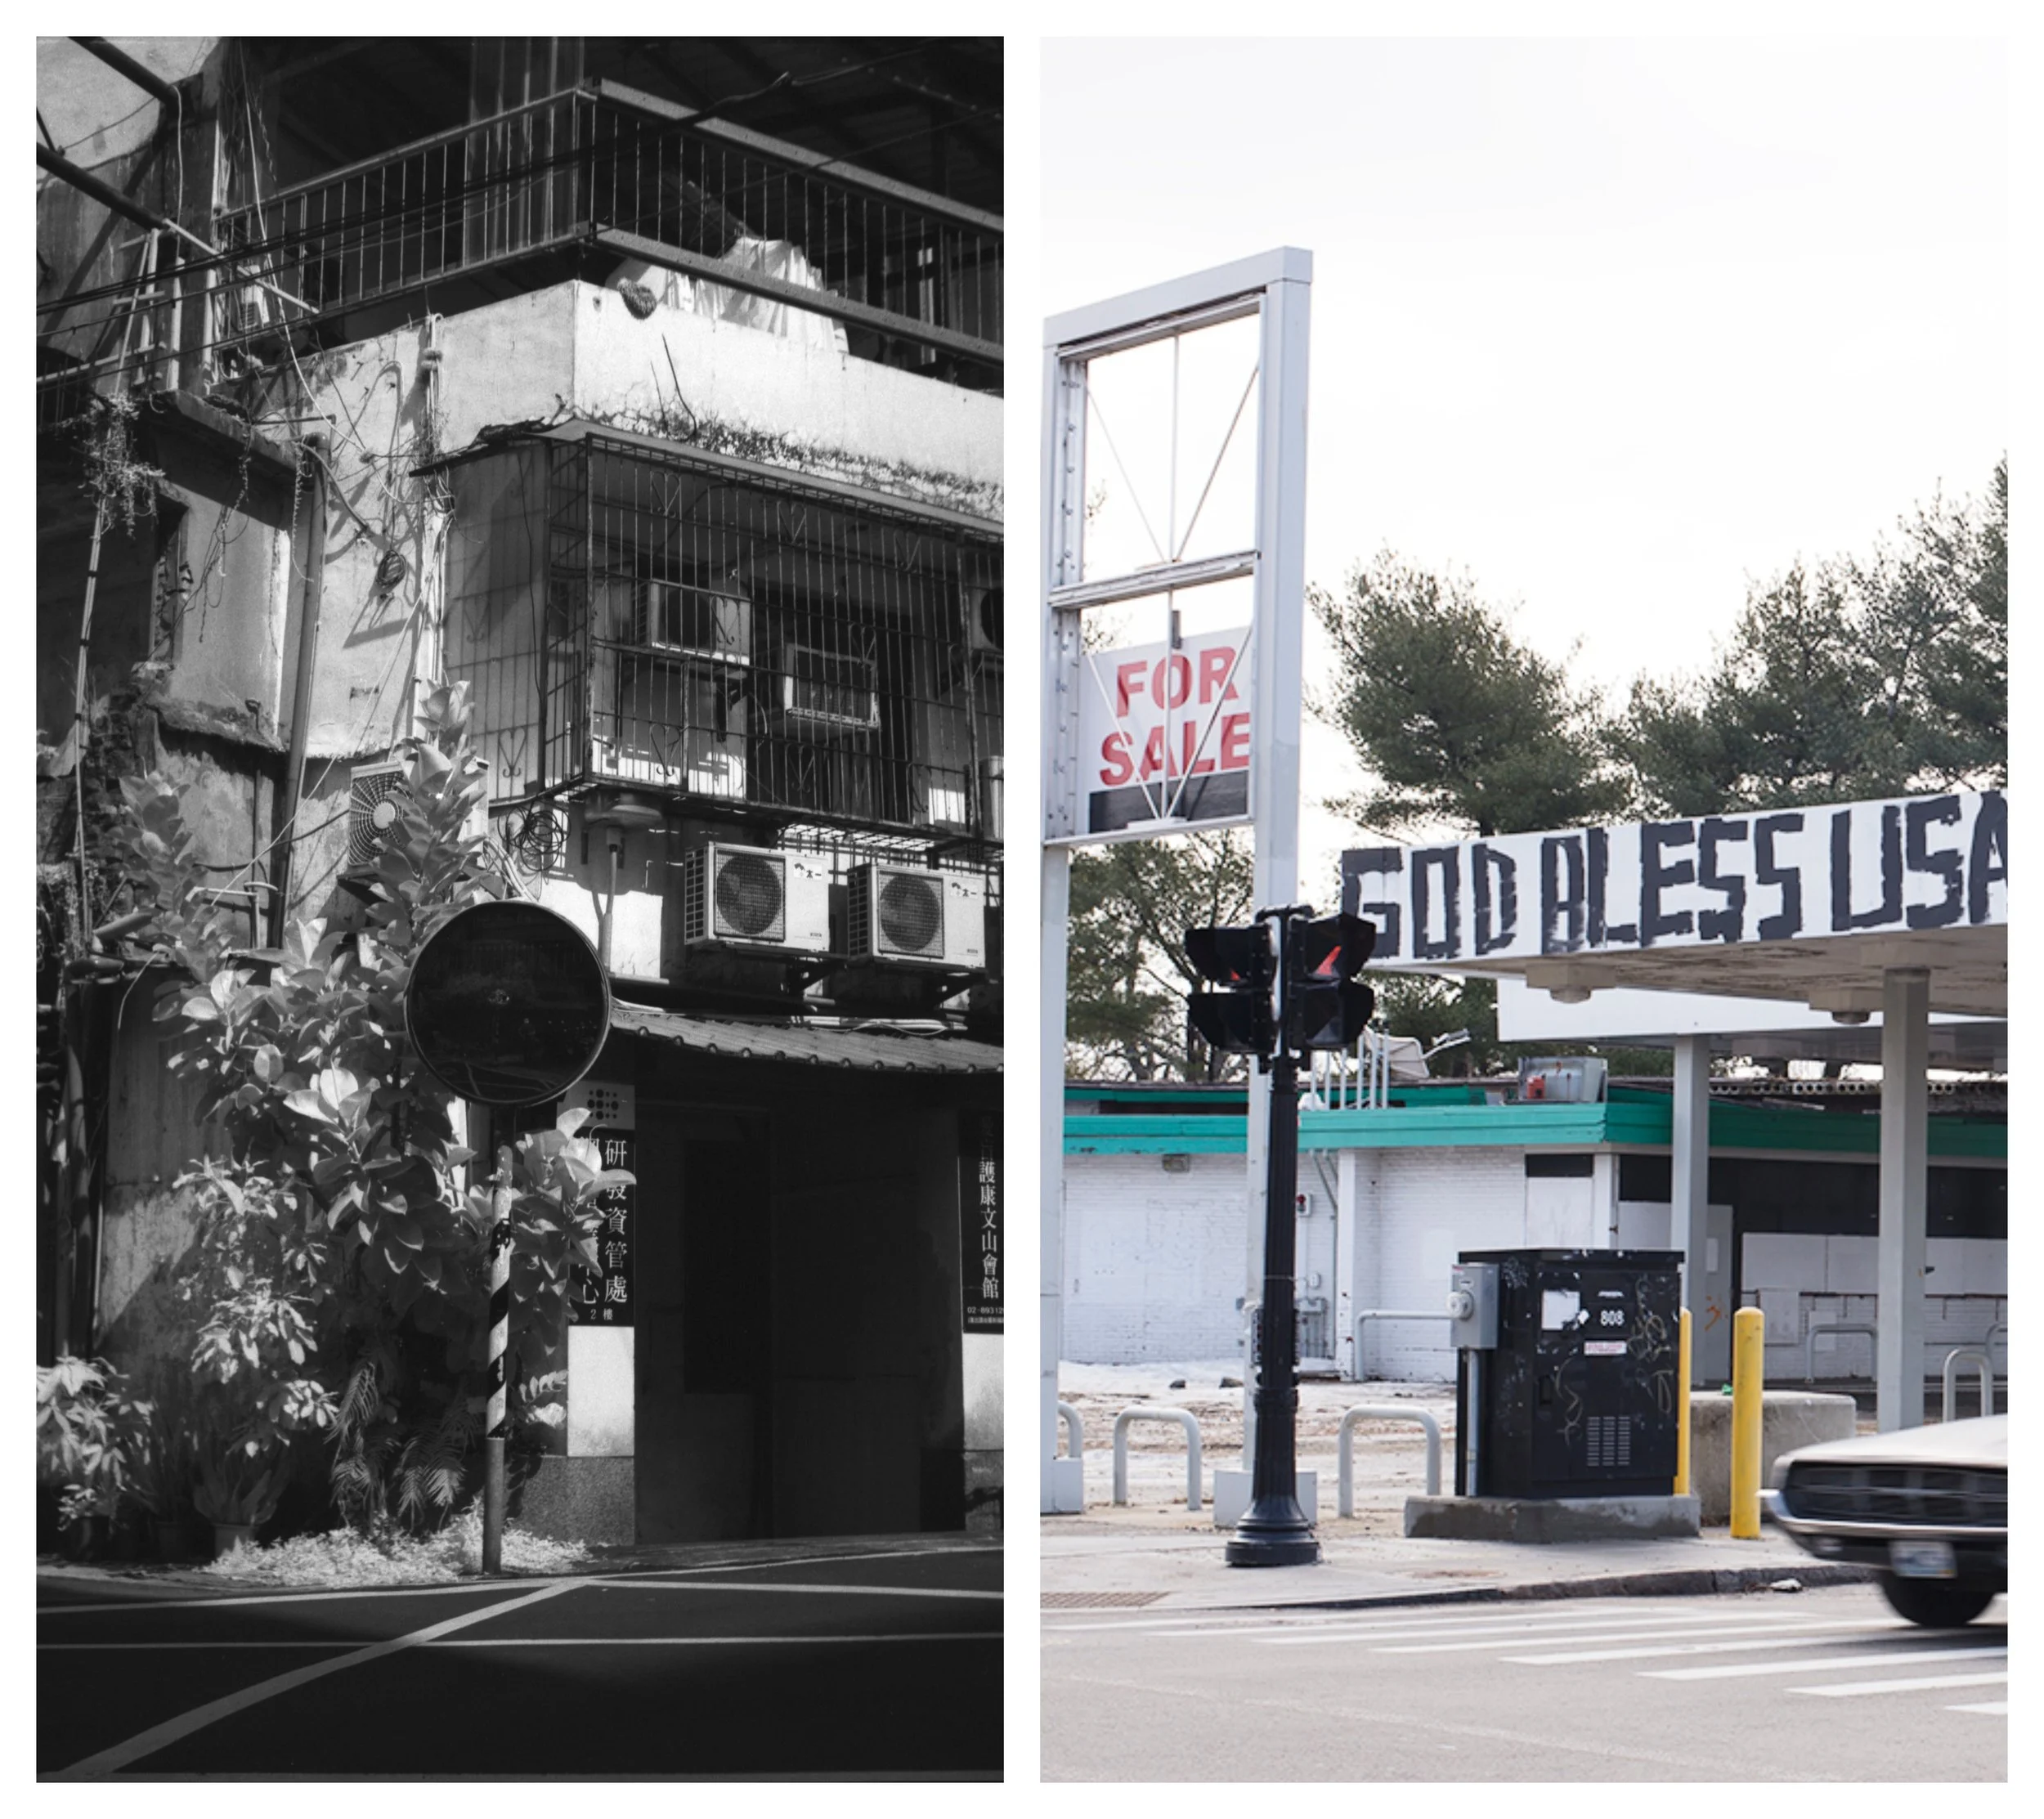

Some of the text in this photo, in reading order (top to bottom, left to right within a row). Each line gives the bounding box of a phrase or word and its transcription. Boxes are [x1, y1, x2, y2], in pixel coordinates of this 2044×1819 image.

[1117, 647, 1239, 717] FOR
[1100, 713, 1250, 786] SALE
[1342, 843, 1516, 961] GOD
[1831, 790, 2008, 932] USA
